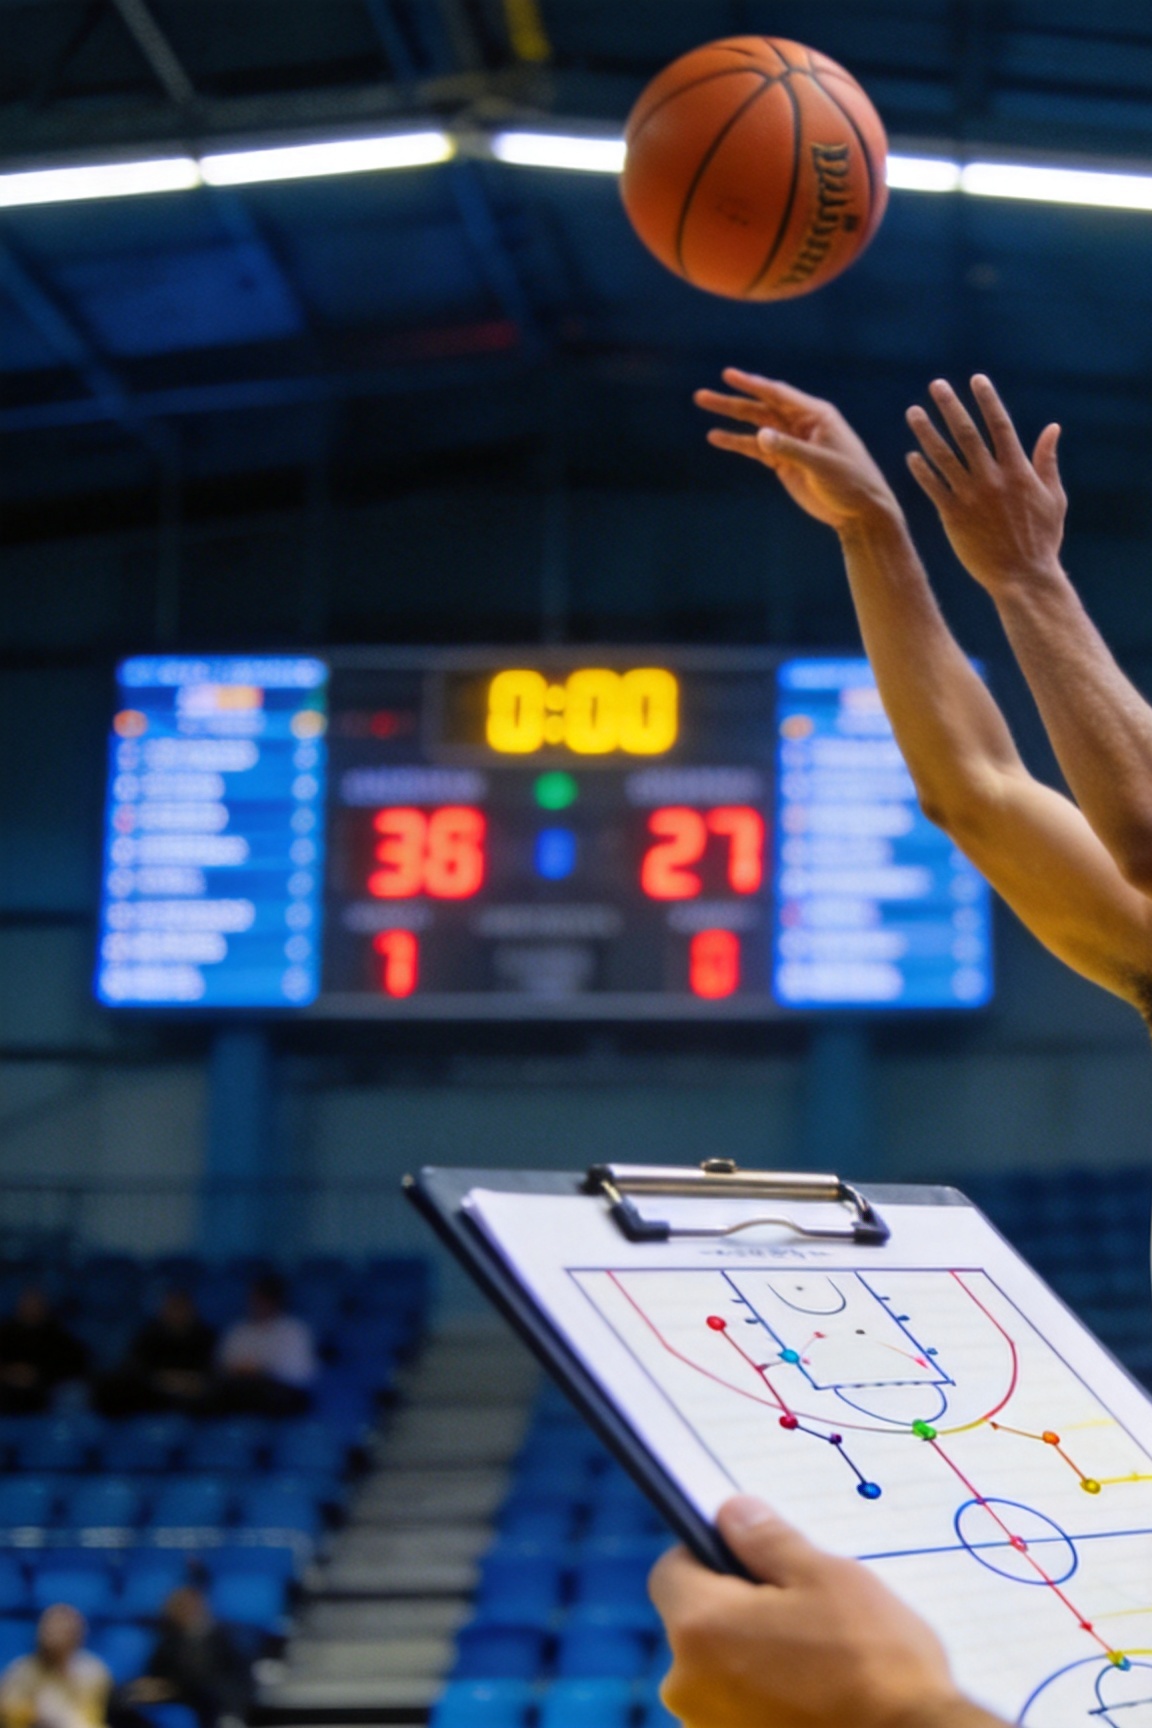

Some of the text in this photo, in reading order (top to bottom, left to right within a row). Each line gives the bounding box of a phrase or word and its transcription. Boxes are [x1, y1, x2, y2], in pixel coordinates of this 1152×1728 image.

[485, 667, 679, 756] 0:00
[640, 804, 766, 901] 27
[374, 928, 419, 998] 1
